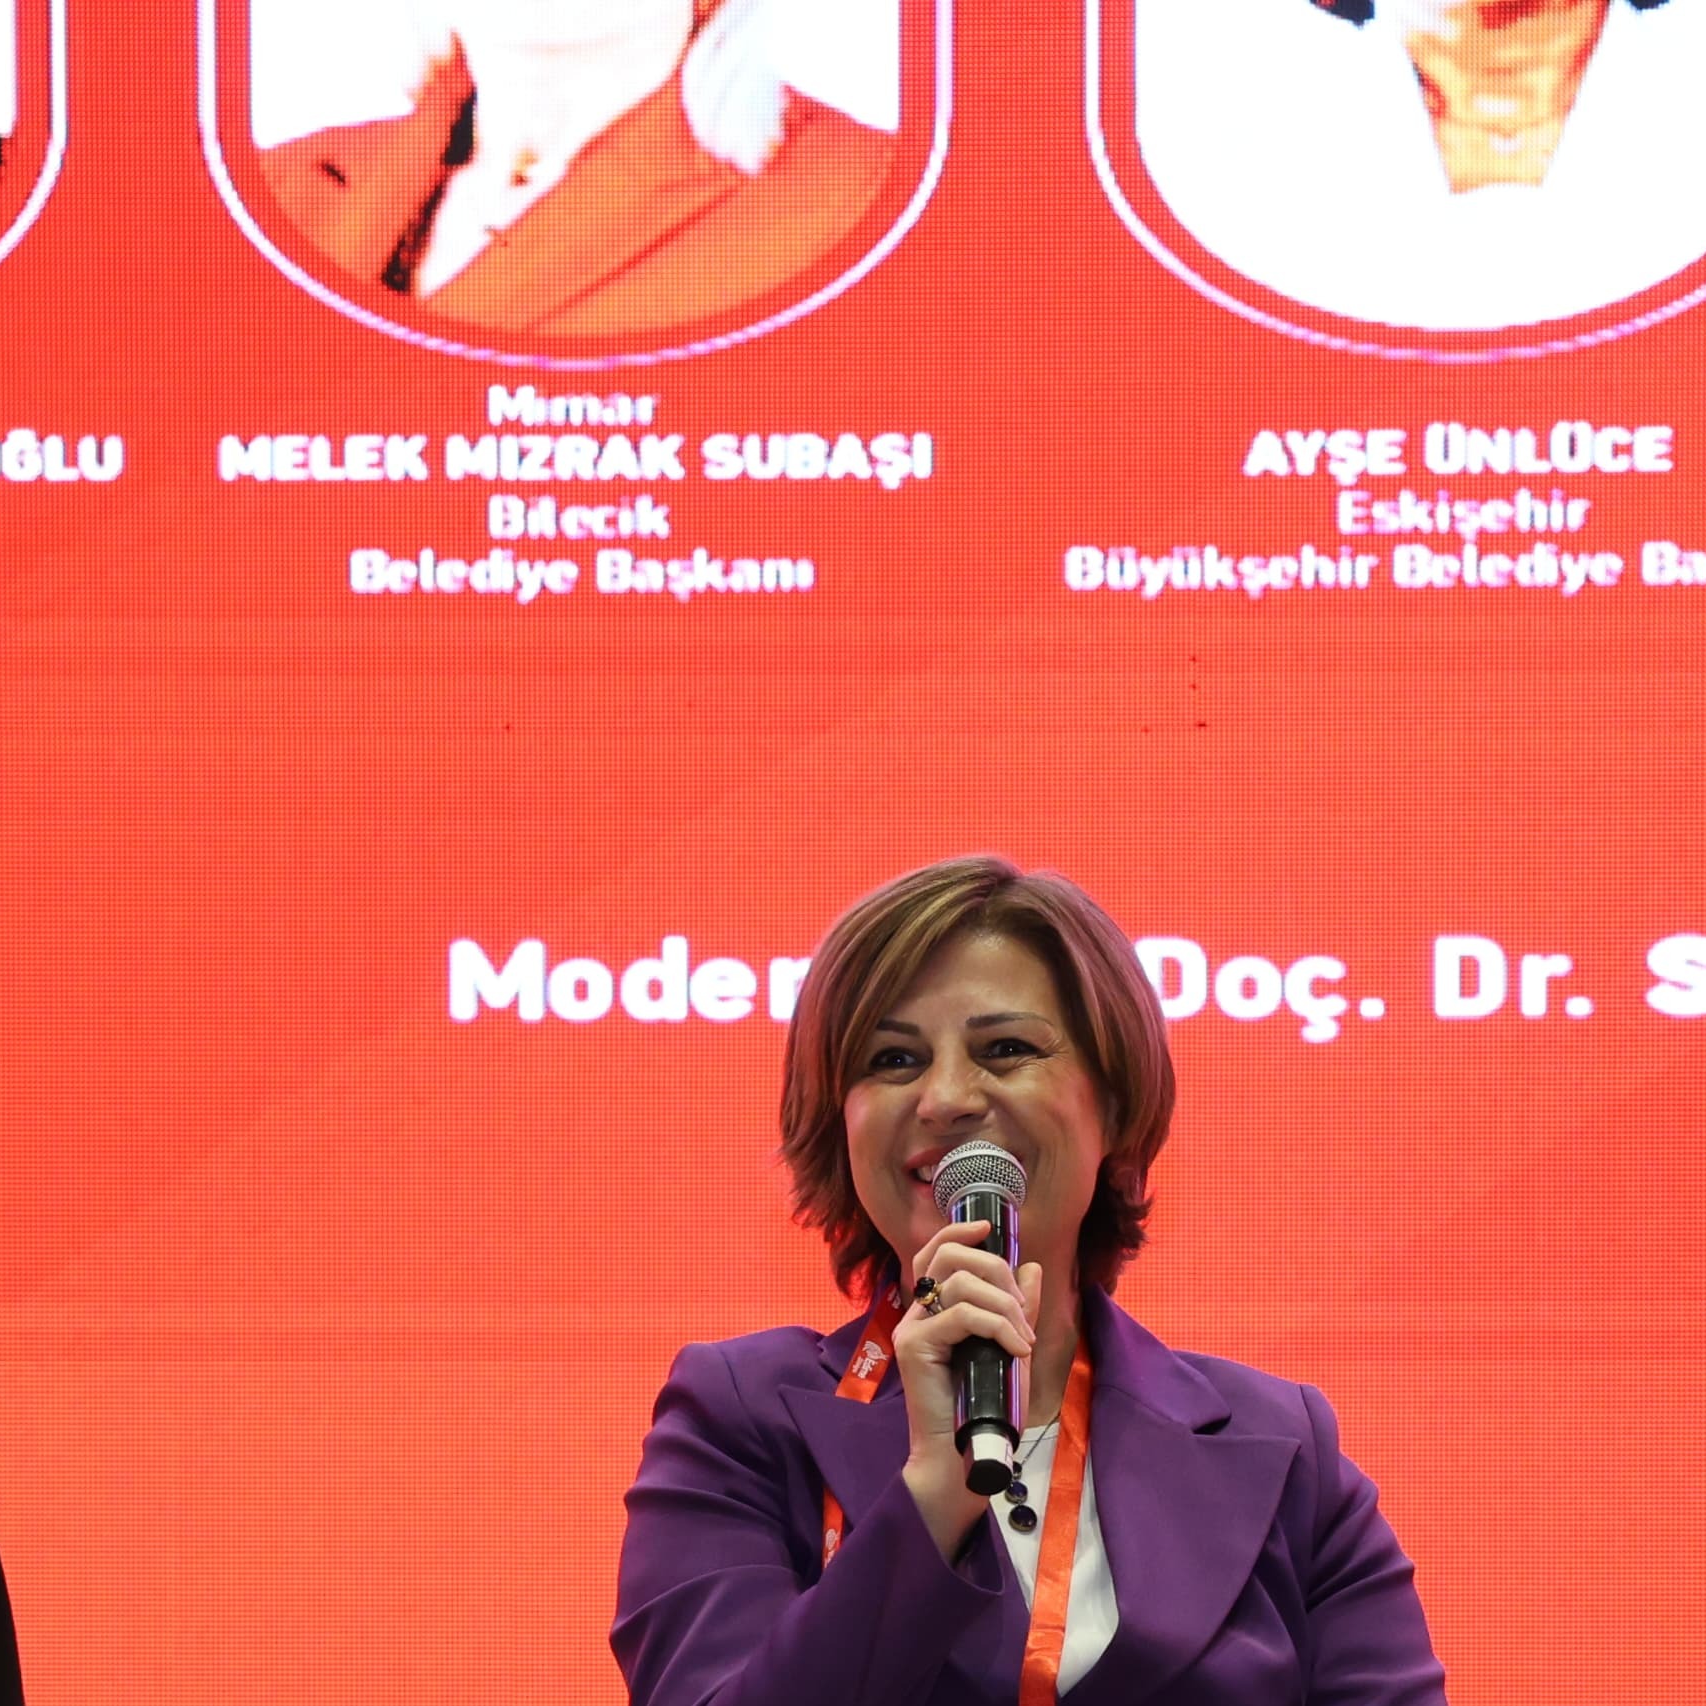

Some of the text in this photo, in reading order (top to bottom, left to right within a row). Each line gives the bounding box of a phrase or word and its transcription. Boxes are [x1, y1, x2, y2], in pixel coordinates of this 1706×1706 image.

[216, 431, 934, 491] MELEK MIZRAK SUBAŞI
[1241, 419, 1675, 489] AYŞE ÜNLÜCE
[487, 493, 672, 541] Bilecik
[1335, 485, 1593, 544] Eskişehir
[348, 546, 816, 606] Belediye Başkanı
[1062, 543, 1381, 601] Büyükşehir
[1390, 539, 1626, 598] Belediye
[446, 933, 814, 1025] Moder
[1427, 932, 1597, 1021] Dr.
